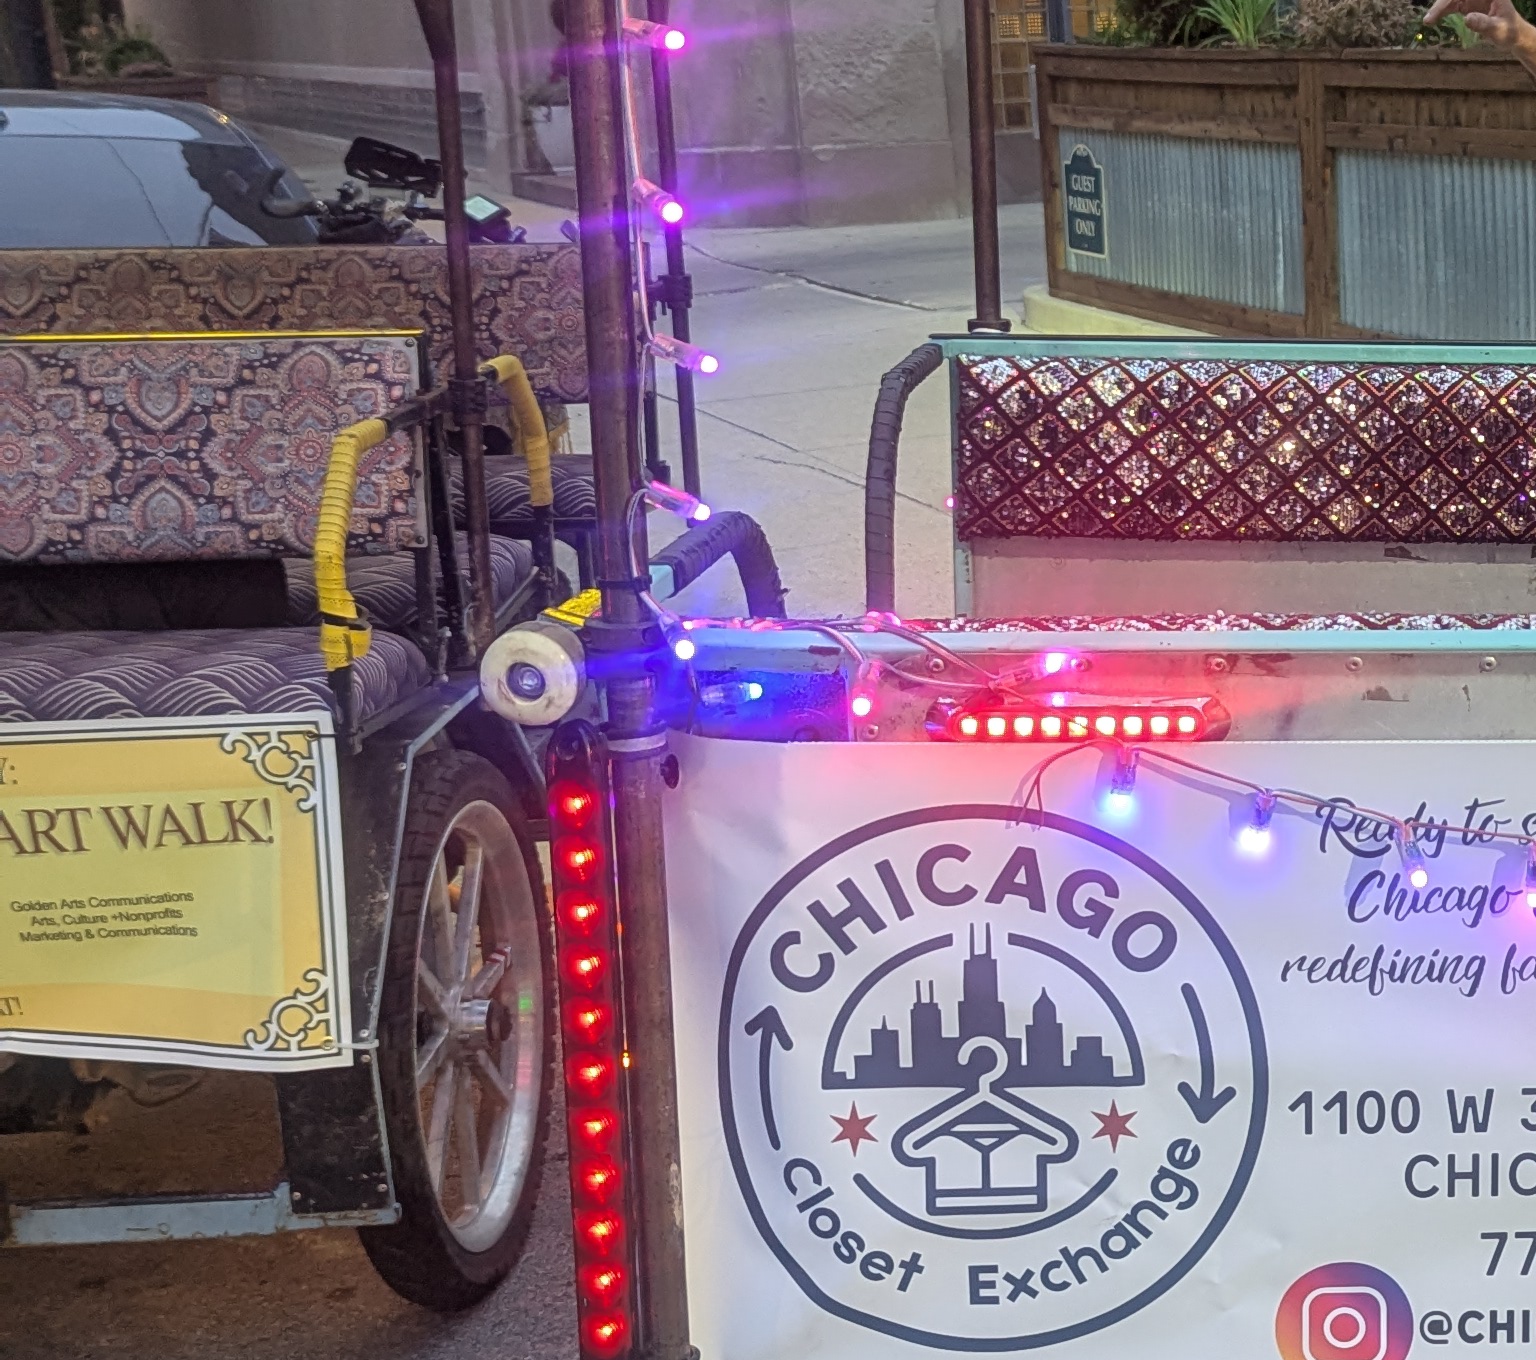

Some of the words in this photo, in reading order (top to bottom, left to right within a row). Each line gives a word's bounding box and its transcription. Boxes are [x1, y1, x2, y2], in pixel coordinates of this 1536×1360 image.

[1069, 195, 1101, 216] PARKING
[1072, 174, 1096, 193] GUEST
[1075, 218, 1096, 237] ONLY
[100, 797, 274, 850] WALK!
[1315, 797, 1448, 859] Ready
[1463, 798, 1512, 847] to
[10, 900, 57, 912] Golden
[61, 898, 86, 909] Arts
[88, 891, 194, 908] Communications
[62, 913, 108, 925] Culture
[769, 843, 1177, 993] CHICAGO
[1346, 868, 1523, 928] Chicago
[19, 930, 83, 942] Marketing
[85, 929, 95, 939] &
[98, 924, 198, 938] Communications
[1281, 943, 1487, 998] redefining
[1287, 1089, 1421, 1135] 1100
[1446, 1088, 1495, 1134] W
[782, 1157, 925, 1292] Closet
[967, 1137, 1201, 1305] Exchange
